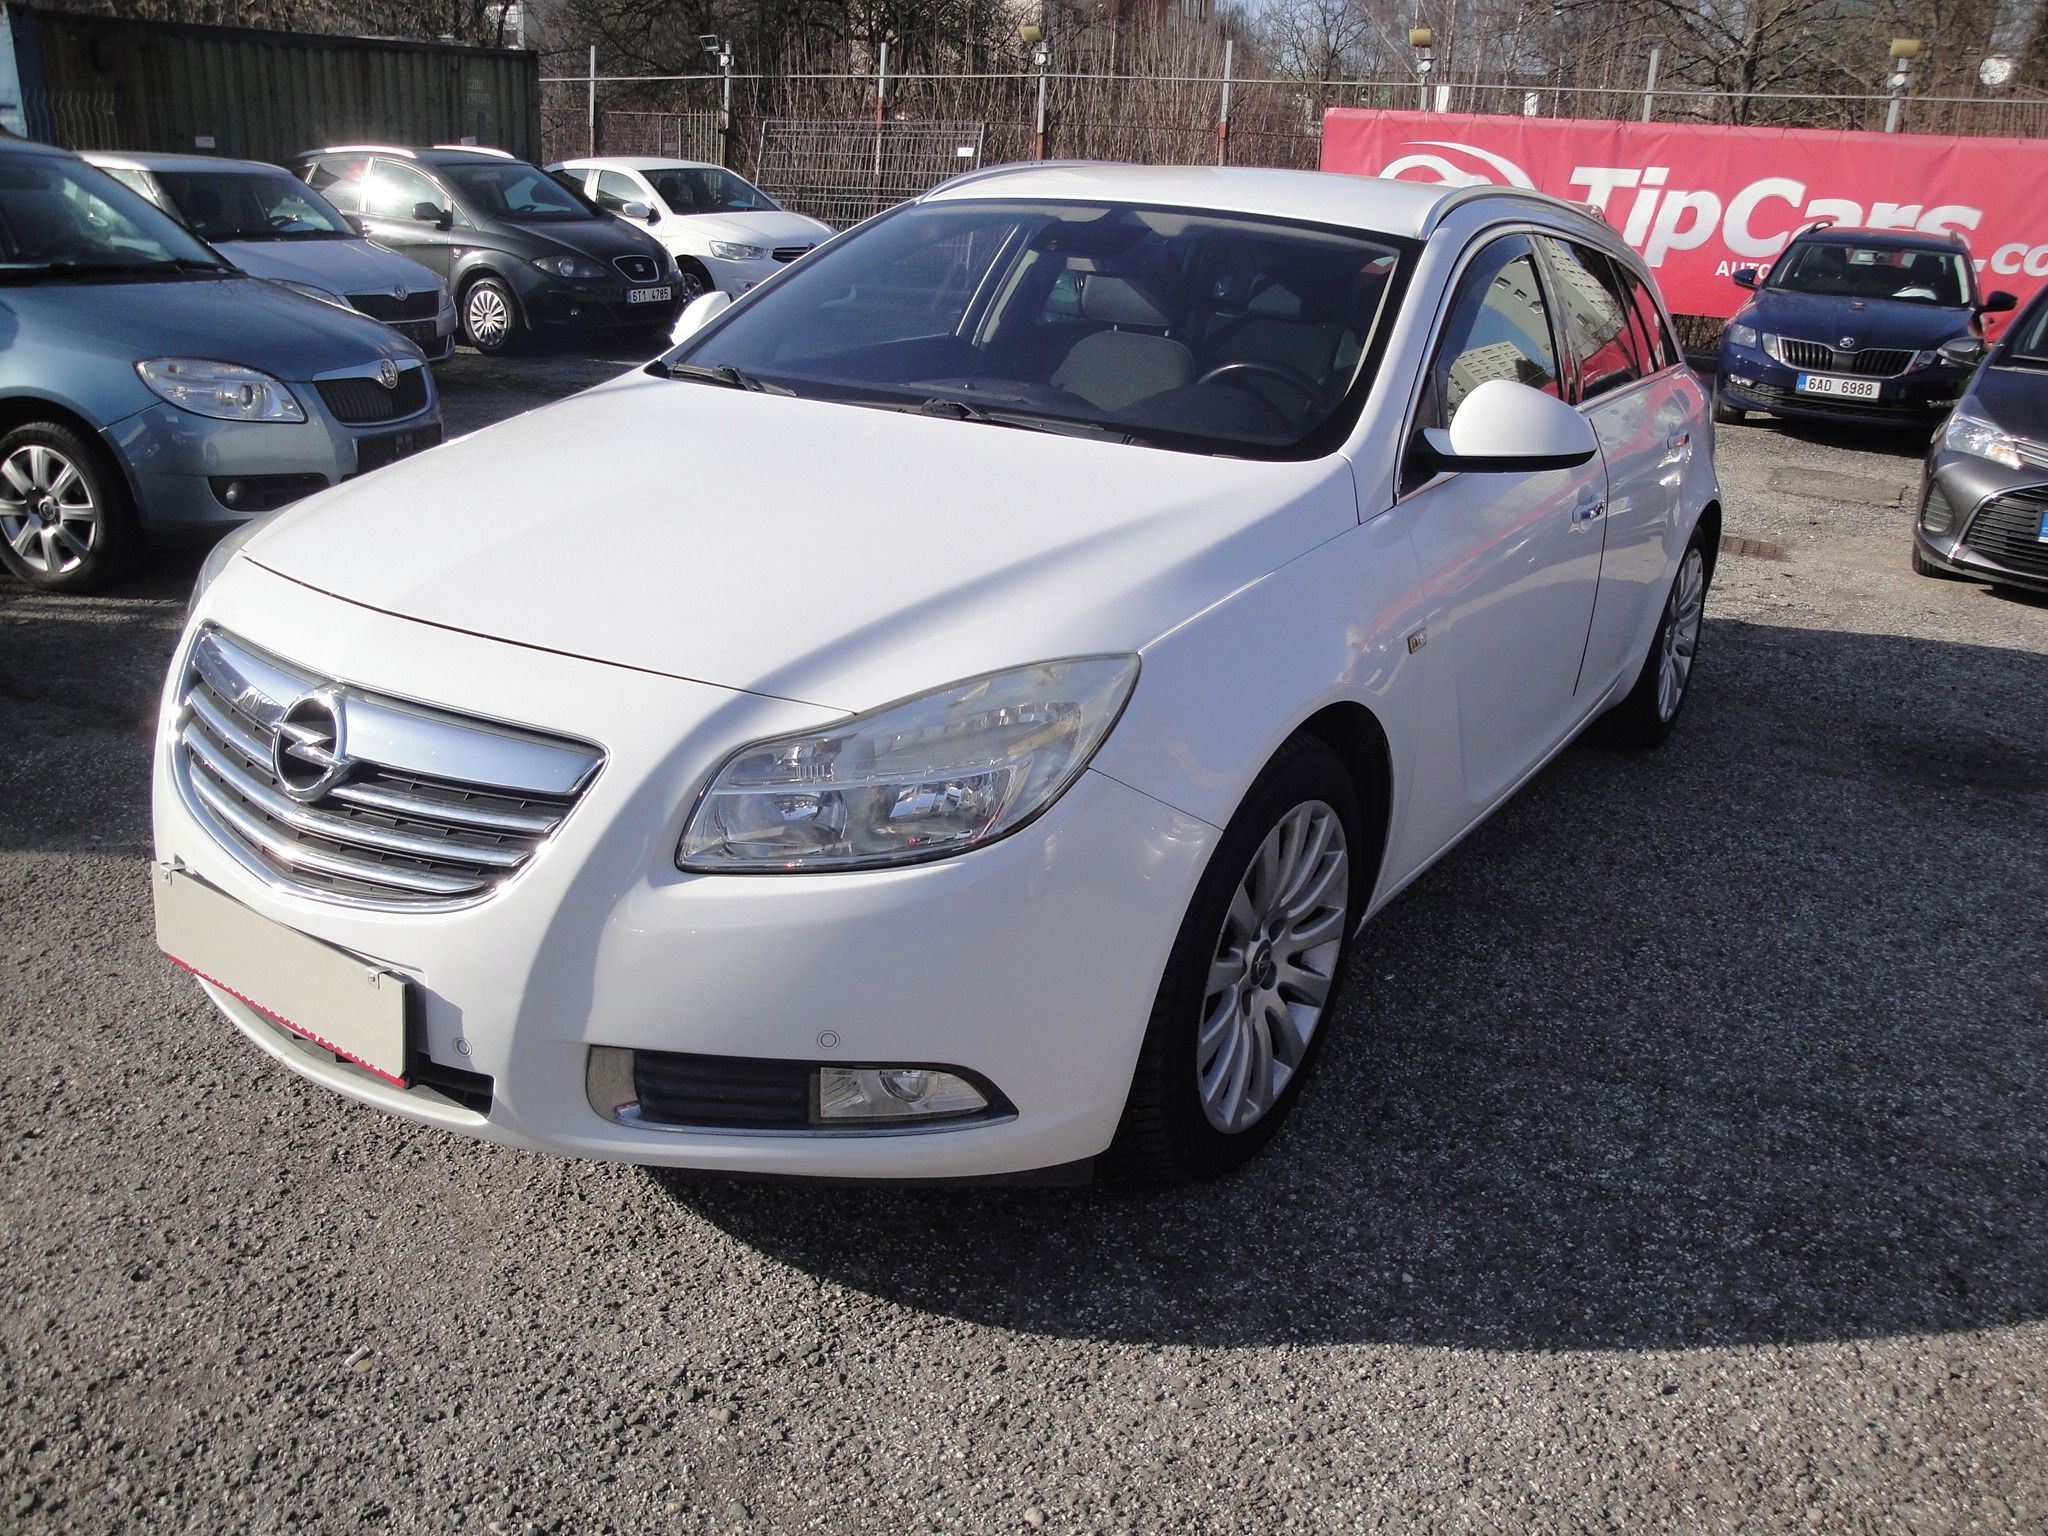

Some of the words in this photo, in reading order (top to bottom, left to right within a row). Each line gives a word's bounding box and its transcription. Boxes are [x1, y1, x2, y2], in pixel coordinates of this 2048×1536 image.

[652, 289, 668, 300] 4785
[1808, 377, 1832, 392] 6AD
[1841, 381, 1873, 396] 6988
